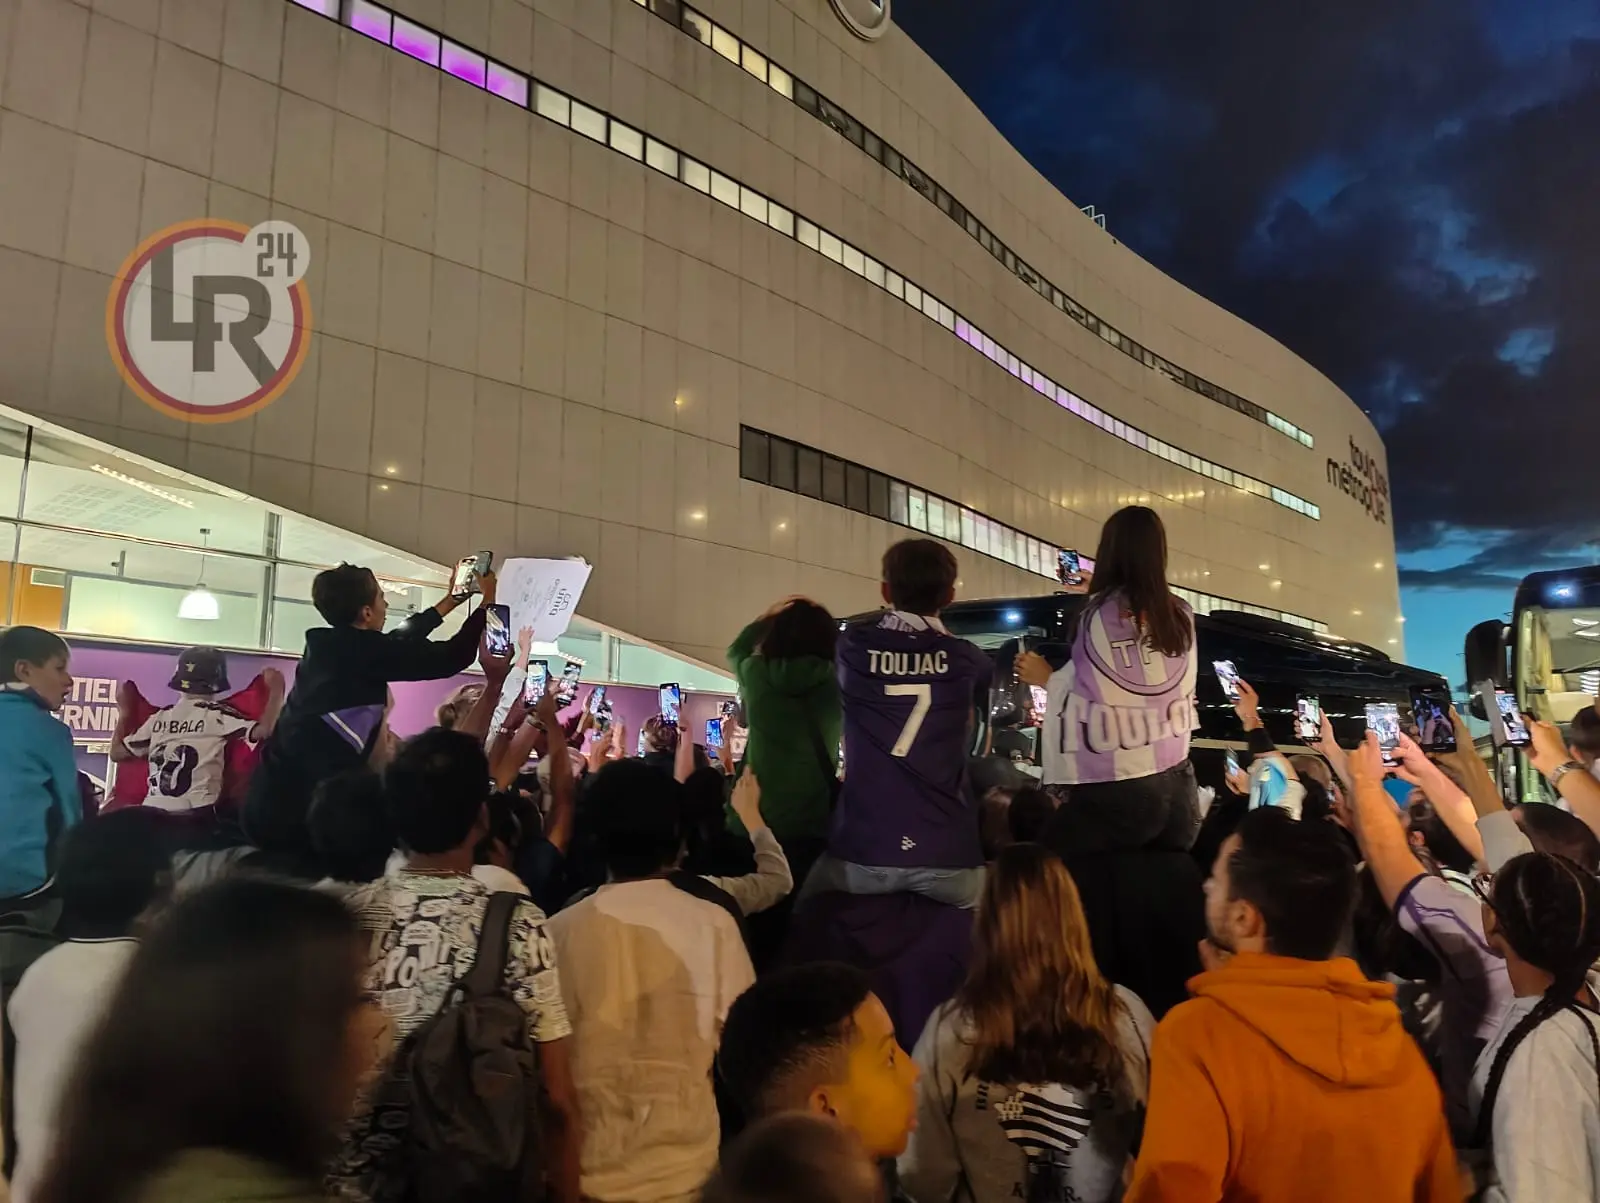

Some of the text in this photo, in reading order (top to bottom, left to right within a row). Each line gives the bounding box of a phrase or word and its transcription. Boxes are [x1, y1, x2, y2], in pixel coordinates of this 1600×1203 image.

[866, 649, 949, 676] TOUJAC
[883, 683, 932, 758] 7
[1058, 690, 1201, 755] TOULO
